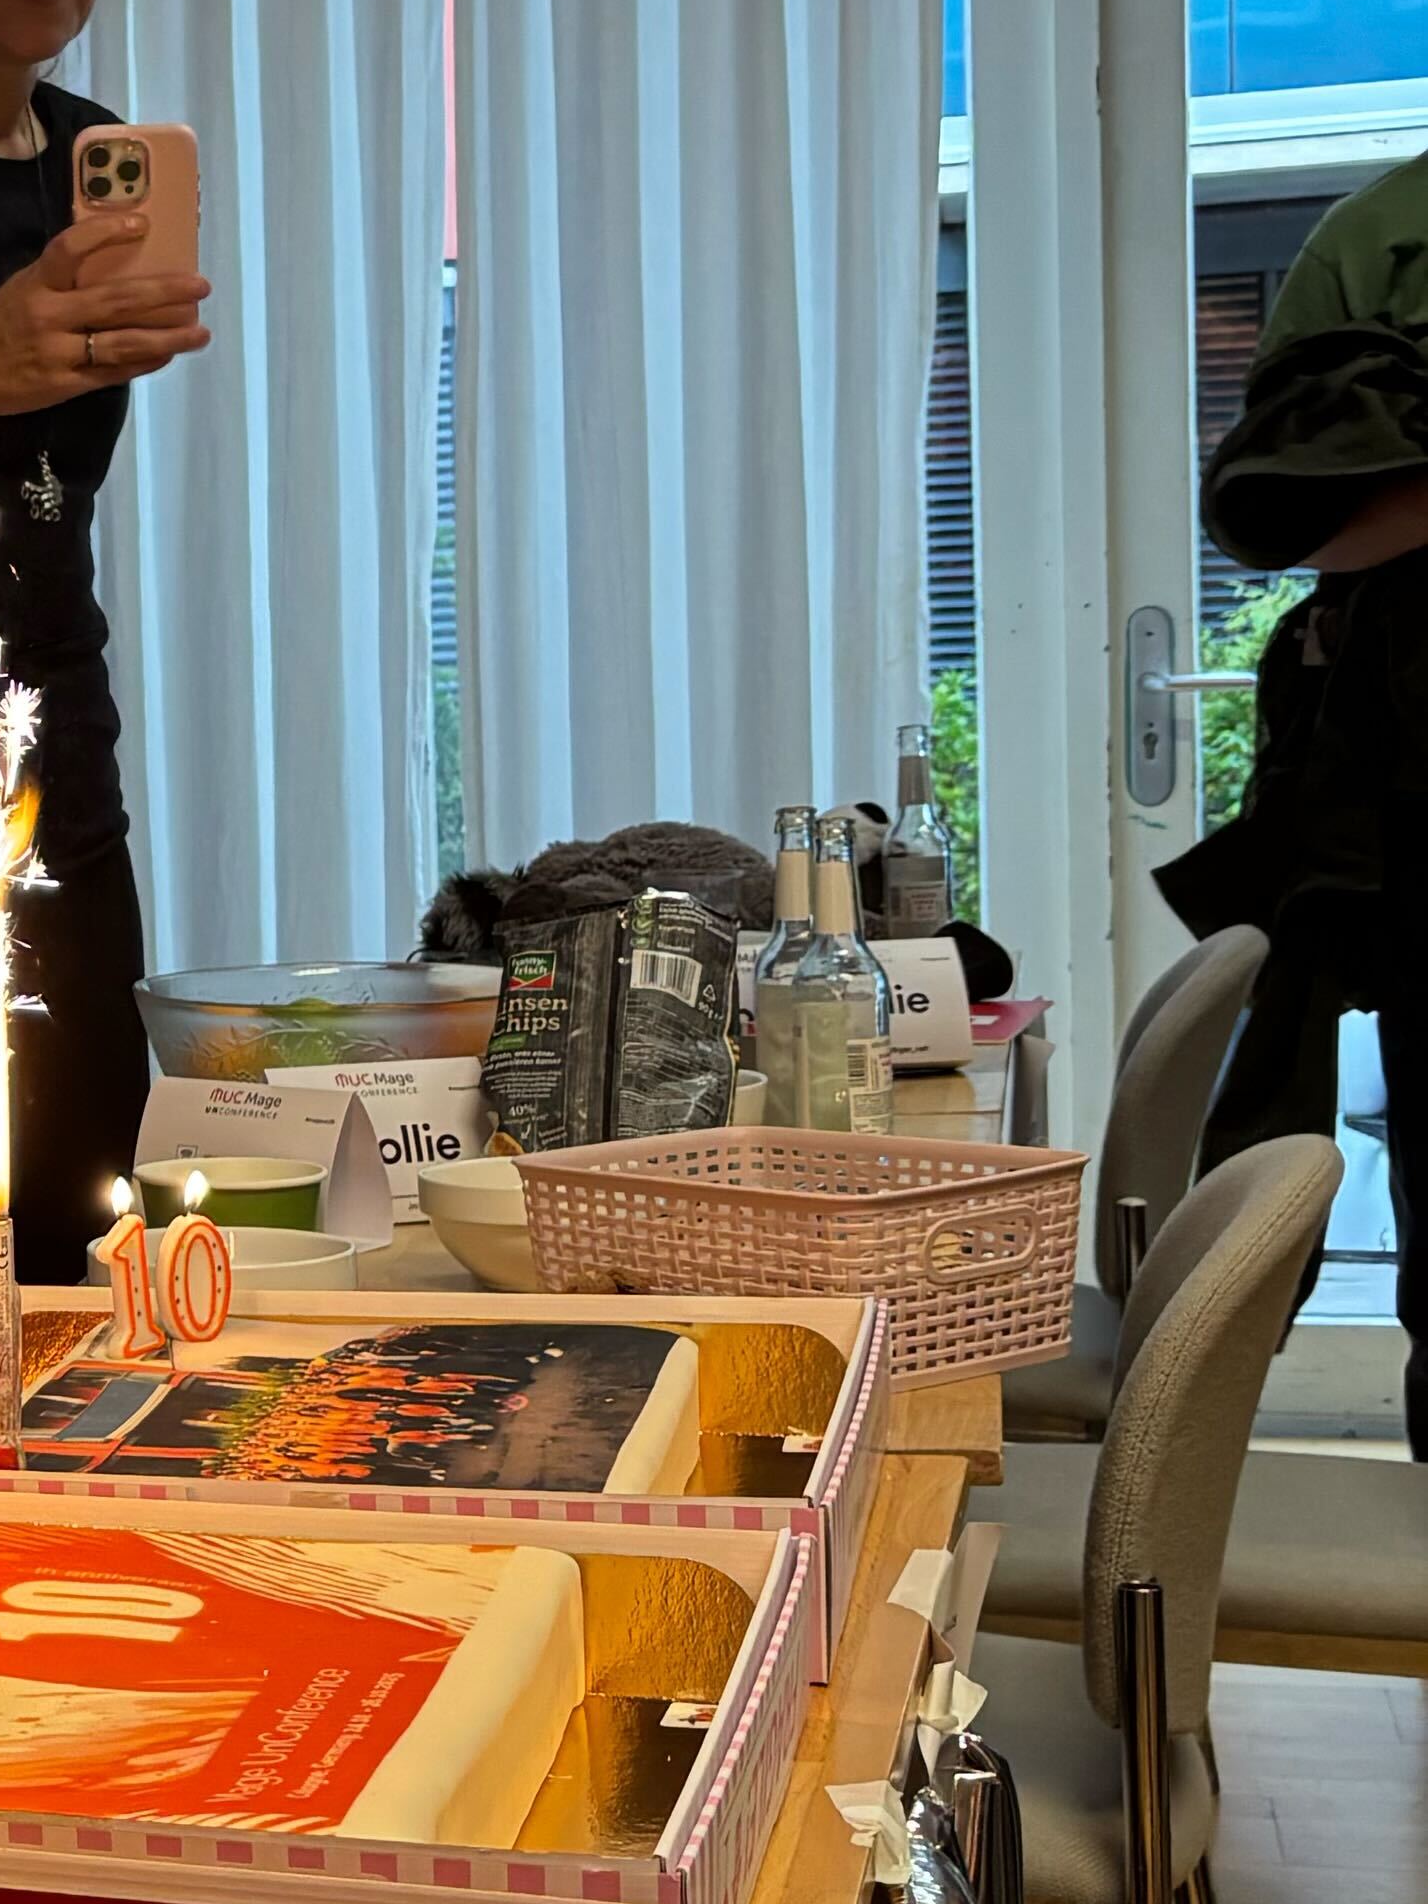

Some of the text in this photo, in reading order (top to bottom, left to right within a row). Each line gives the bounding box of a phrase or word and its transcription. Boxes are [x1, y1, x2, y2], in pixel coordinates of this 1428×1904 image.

[499, 995, 569, 1014] insen
[373, 1072, 415, 1086] Mage
[208, 1087, 283, 1109] MUC Mage
[204, 1106, 278, 1120] UNCONFERENCE
[378, 1123, 462, 1165] ollie
[239, 1667, 352, 1767] UnConference
